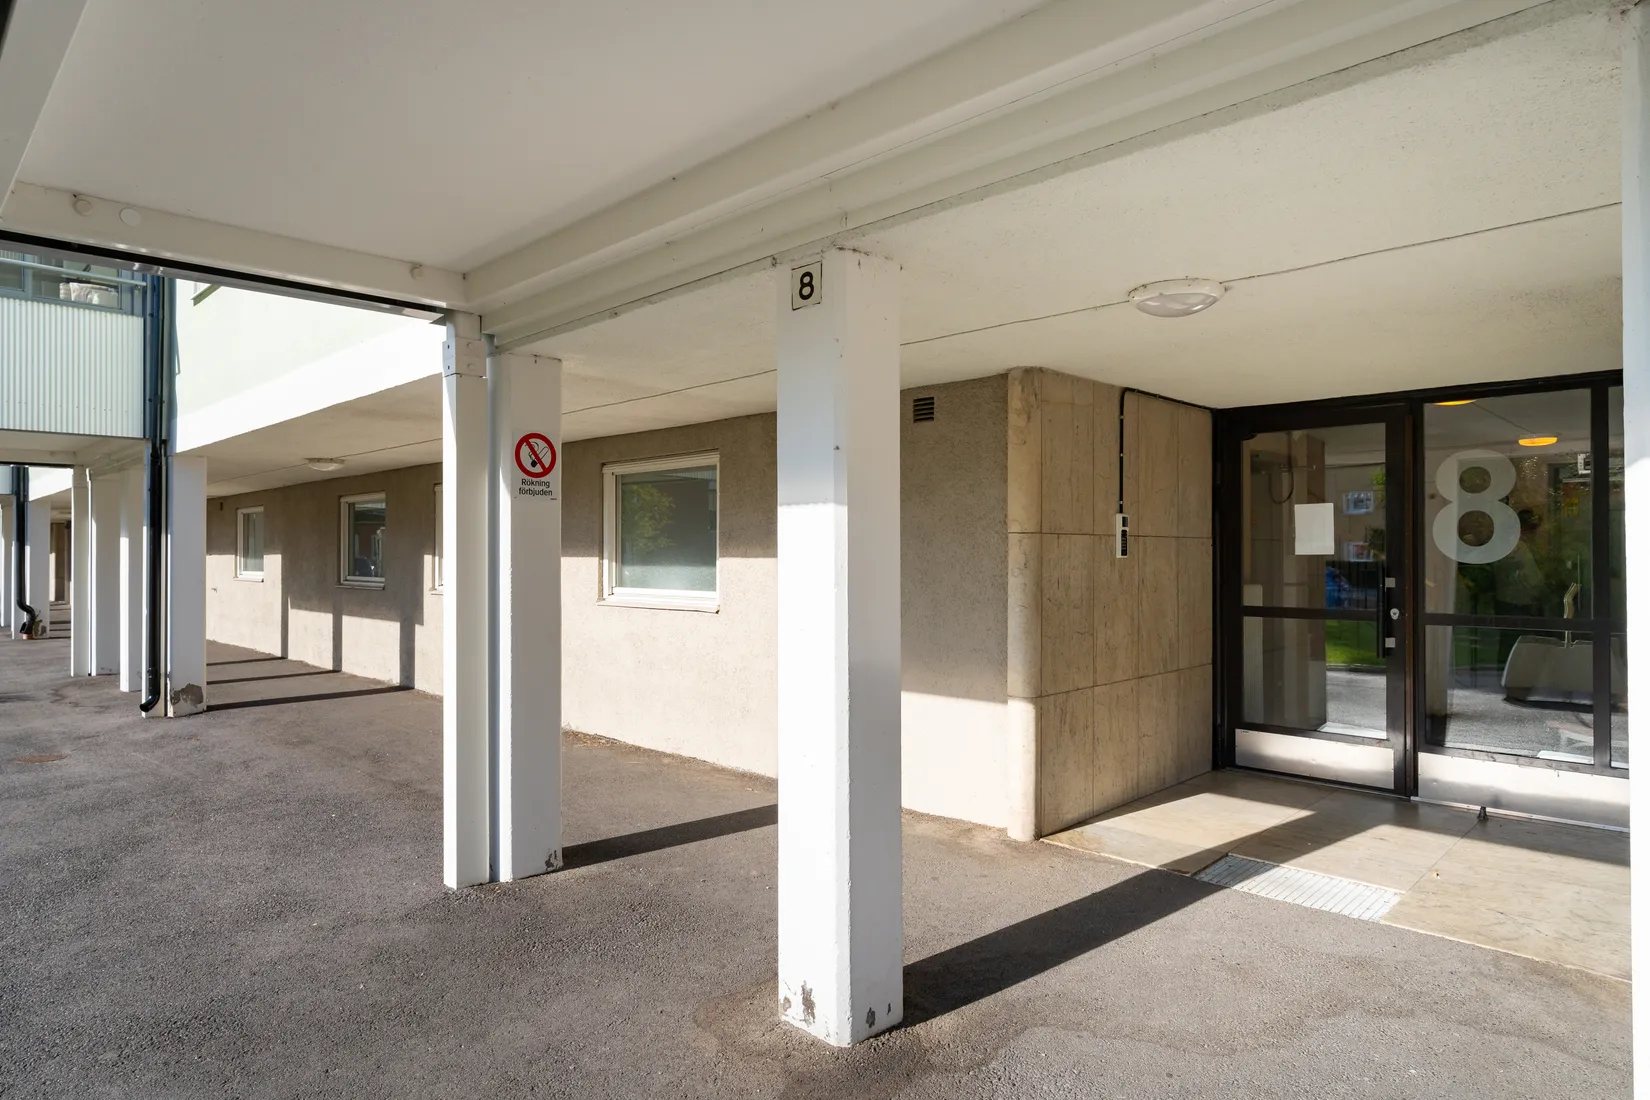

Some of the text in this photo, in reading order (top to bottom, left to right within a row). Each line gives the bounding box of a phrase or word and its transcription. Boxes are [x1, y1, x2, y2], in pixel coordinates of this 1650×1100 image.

[799, 271, 814, 300] 8
[518, 487, 552, 496] förbjuden
[521, 478, 551, 488] Rökning
[1432, 449, 1521, 565] 8
